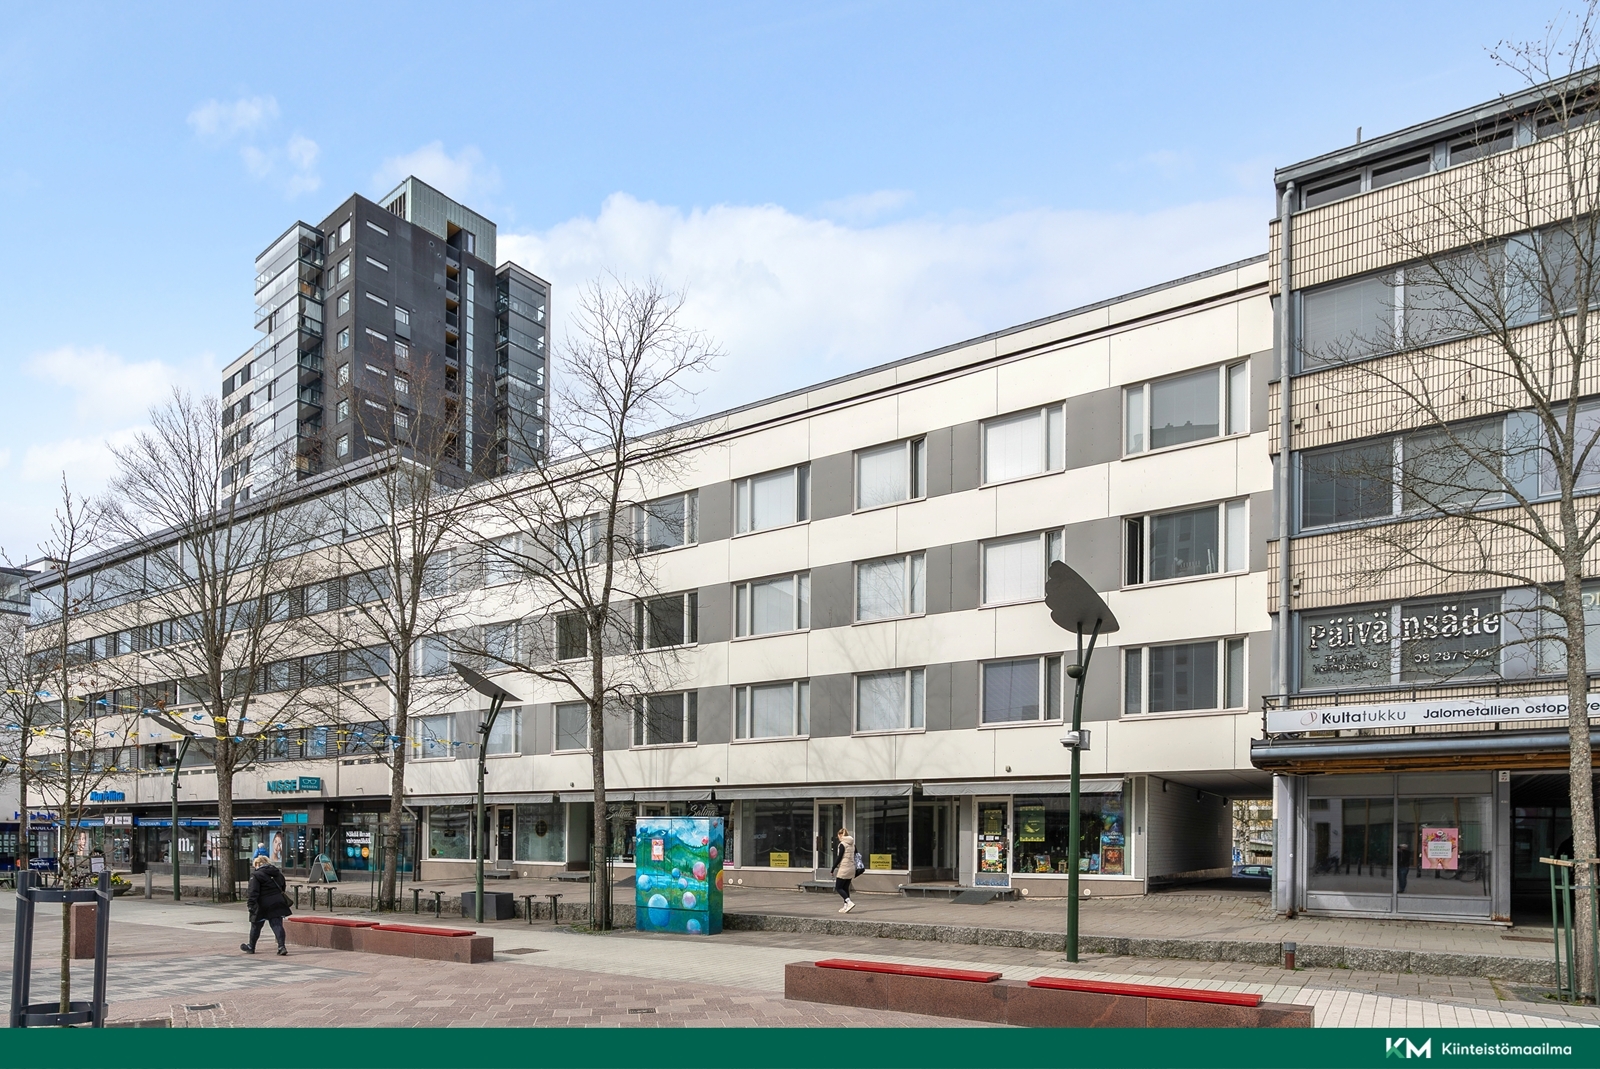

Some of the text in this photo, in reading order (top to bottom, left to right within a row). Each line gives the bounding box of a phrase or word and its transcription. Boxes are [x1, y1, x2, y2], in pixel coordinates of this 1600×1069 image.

[1414, 653, 1430, 663] 09
[1322, 709, 1406, 724] Kultatukku
[1423, 703, 1519, 719] Jalometallien
[267, 779, 297, 791] NISSE
